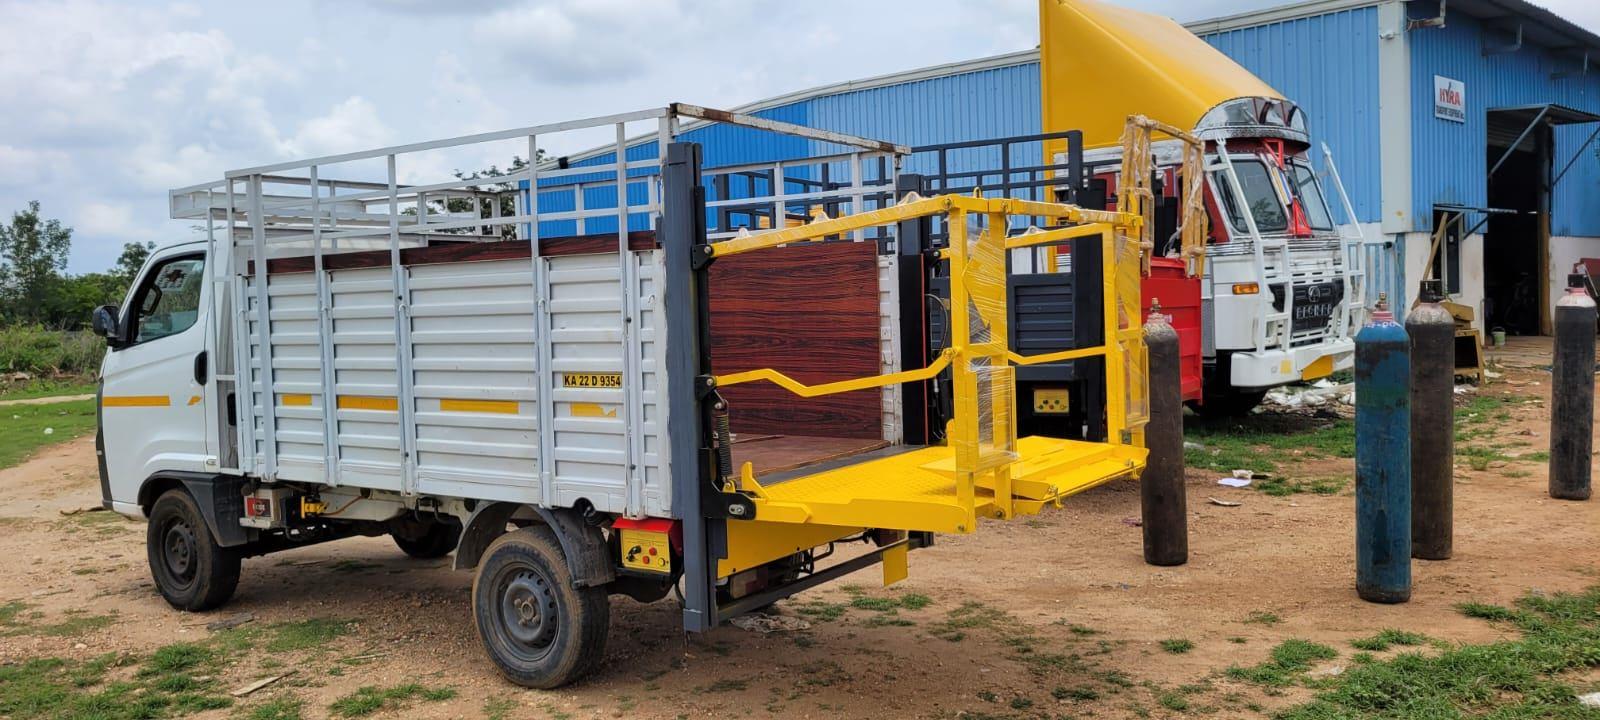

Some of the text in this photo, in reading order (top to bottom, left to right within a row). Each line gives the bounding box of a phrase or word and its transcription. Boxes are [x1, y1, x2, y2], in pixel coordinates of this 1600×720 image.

[564, 375, 621, 387] KA 22 D 9354
